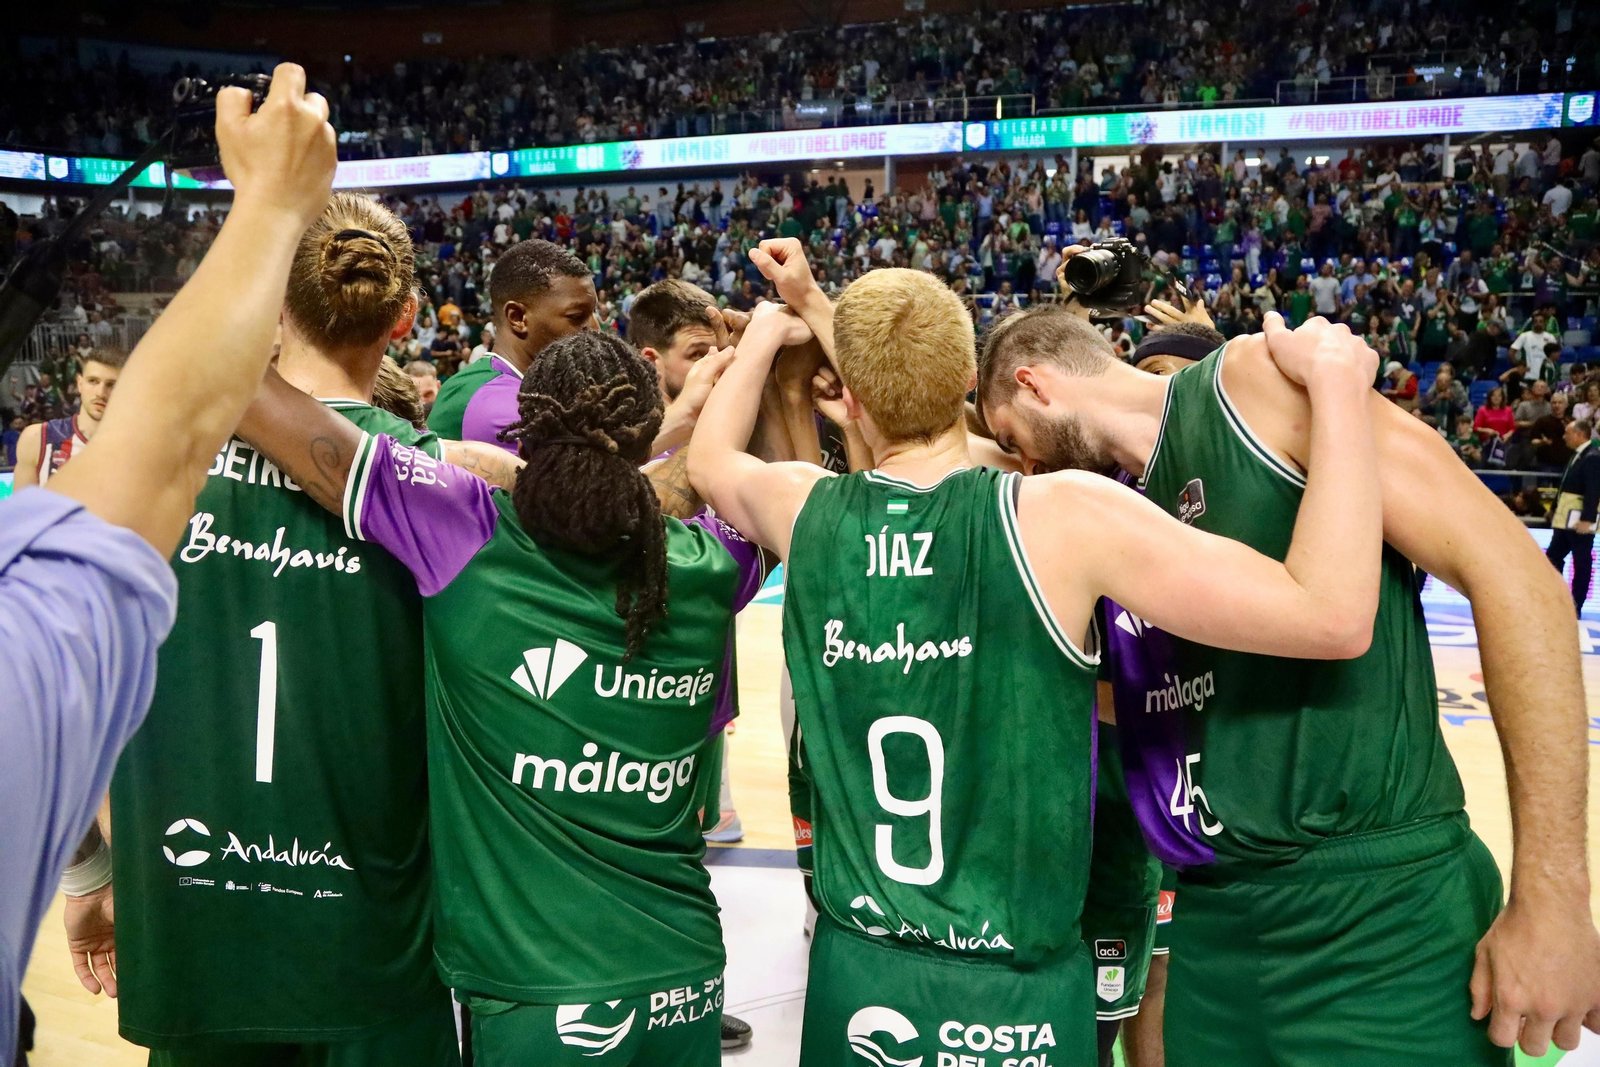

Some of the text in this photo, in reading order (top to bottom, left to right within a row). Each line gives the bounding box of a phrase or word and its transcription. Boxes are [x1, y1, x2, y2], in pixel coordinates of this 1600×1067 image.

[1288, 105, 1465, 131] #ROADTOBELGRADE
[749, 131, 887, 155] #ROADTOBELGRADE
[250, 621, 277, 783] 1
[594, 664, 714, 706] Unicaja
[1145, 671, 1216, 713] málaga
[512, 742, 696, 804] málaga
[867, 716, 945, 886] 9
[1170, 753, 1225, 837] 45
[220, 831, 355, 870] Andalucía
[1100, 947, 1119, 956] acb
[650, 986, 700, 1013] DEL
[938, 1020, 1056, 1053] COSTA
